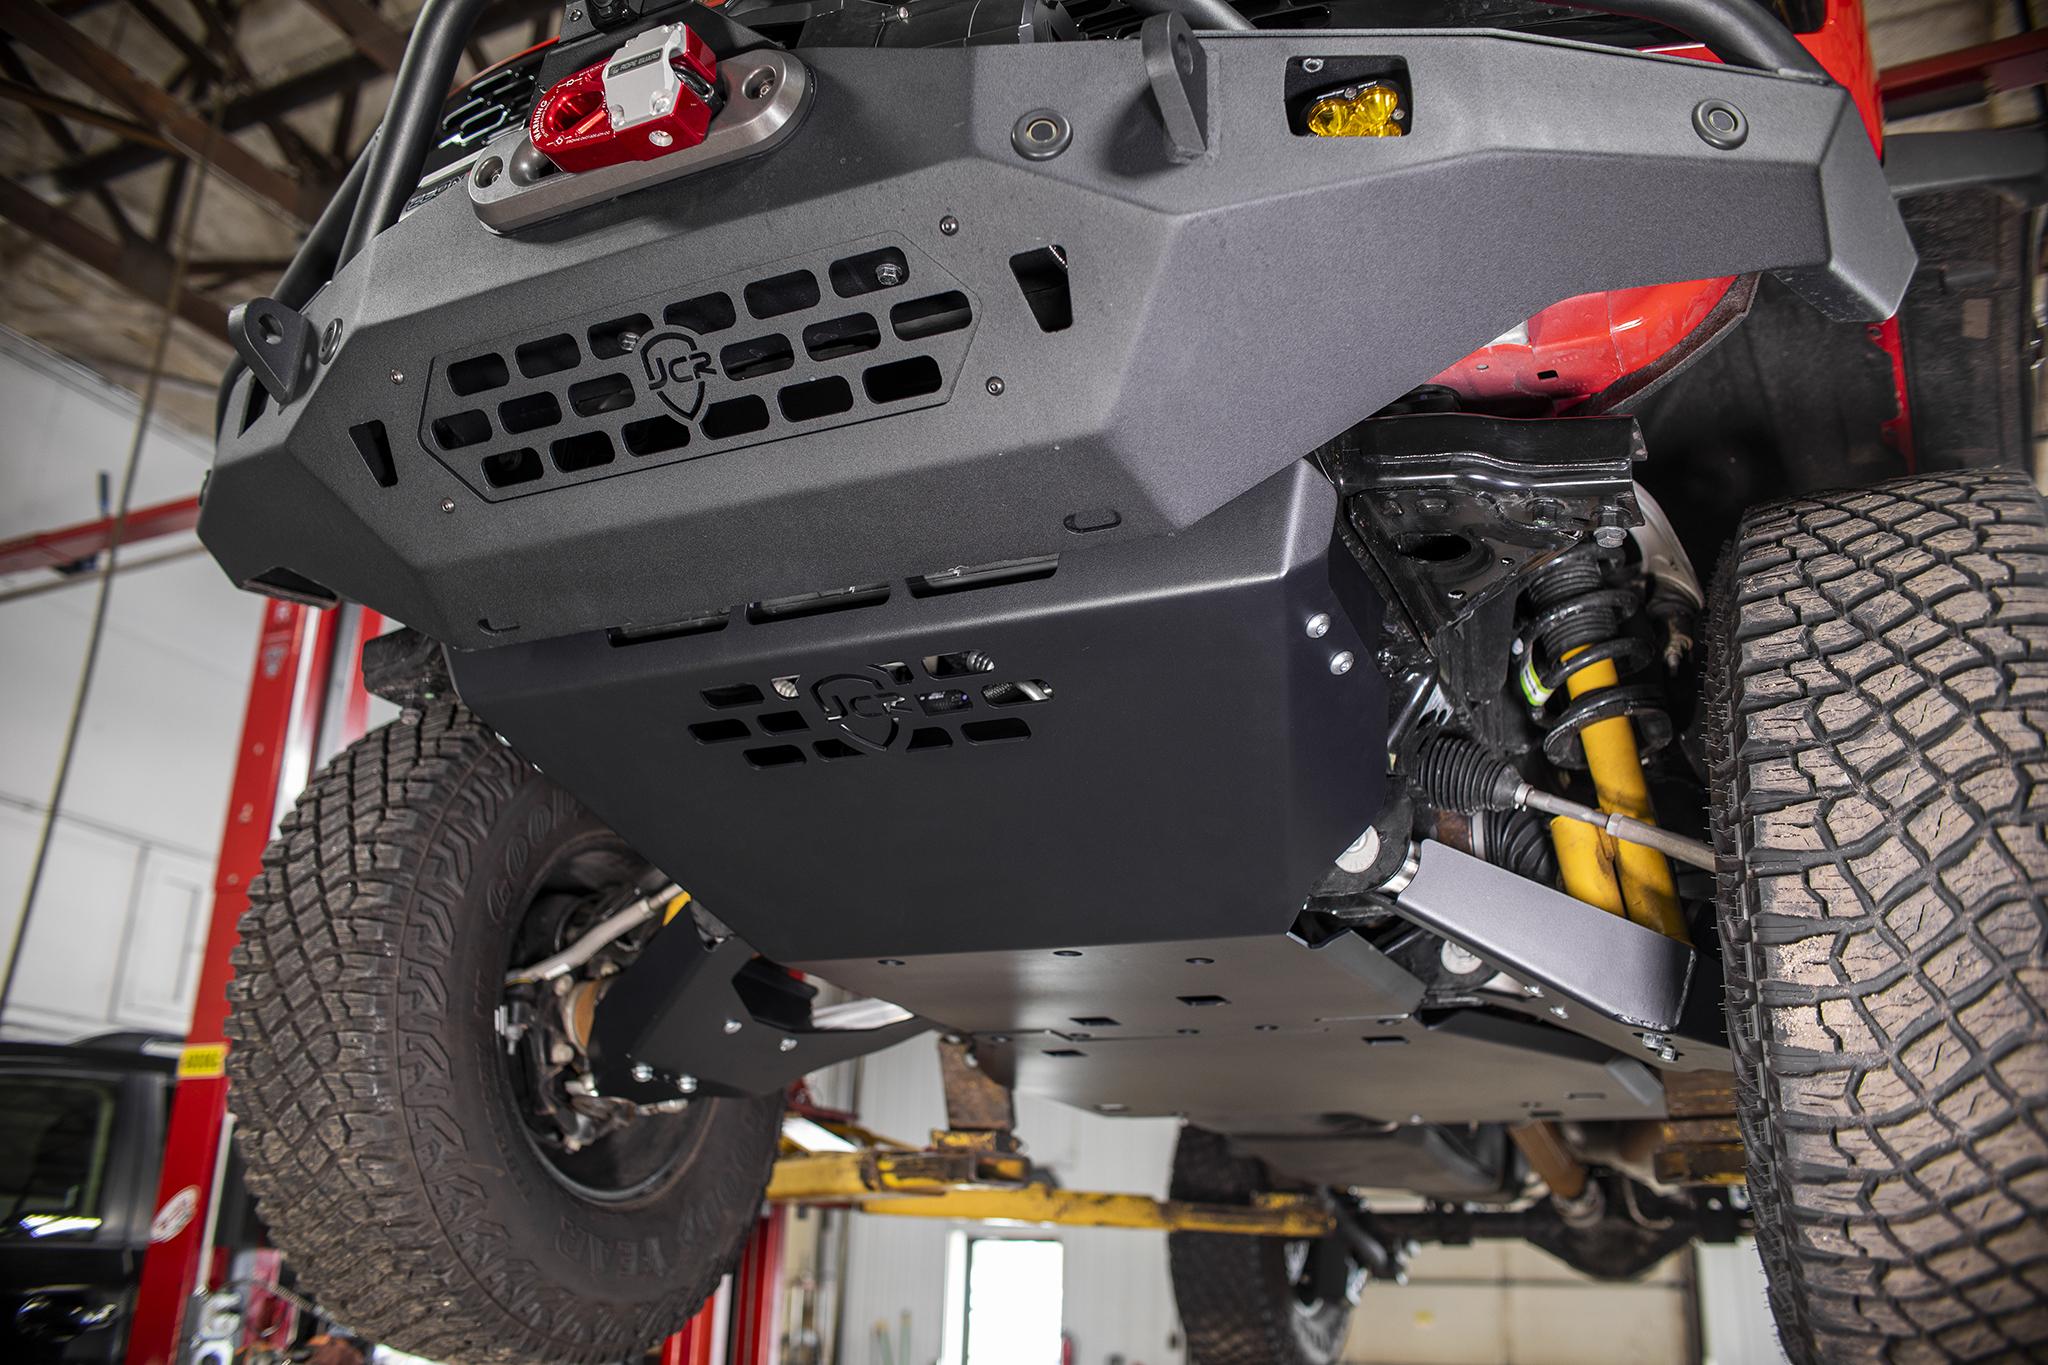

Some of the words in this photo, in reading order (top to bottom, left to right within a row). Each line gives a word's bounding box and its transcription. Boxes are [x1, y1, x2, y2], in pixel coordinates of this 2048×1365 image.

[532, 99, 549, 142] WARNING
[648, 351, 718, 391] JCR
[826, 693, 913, 722] JCR
